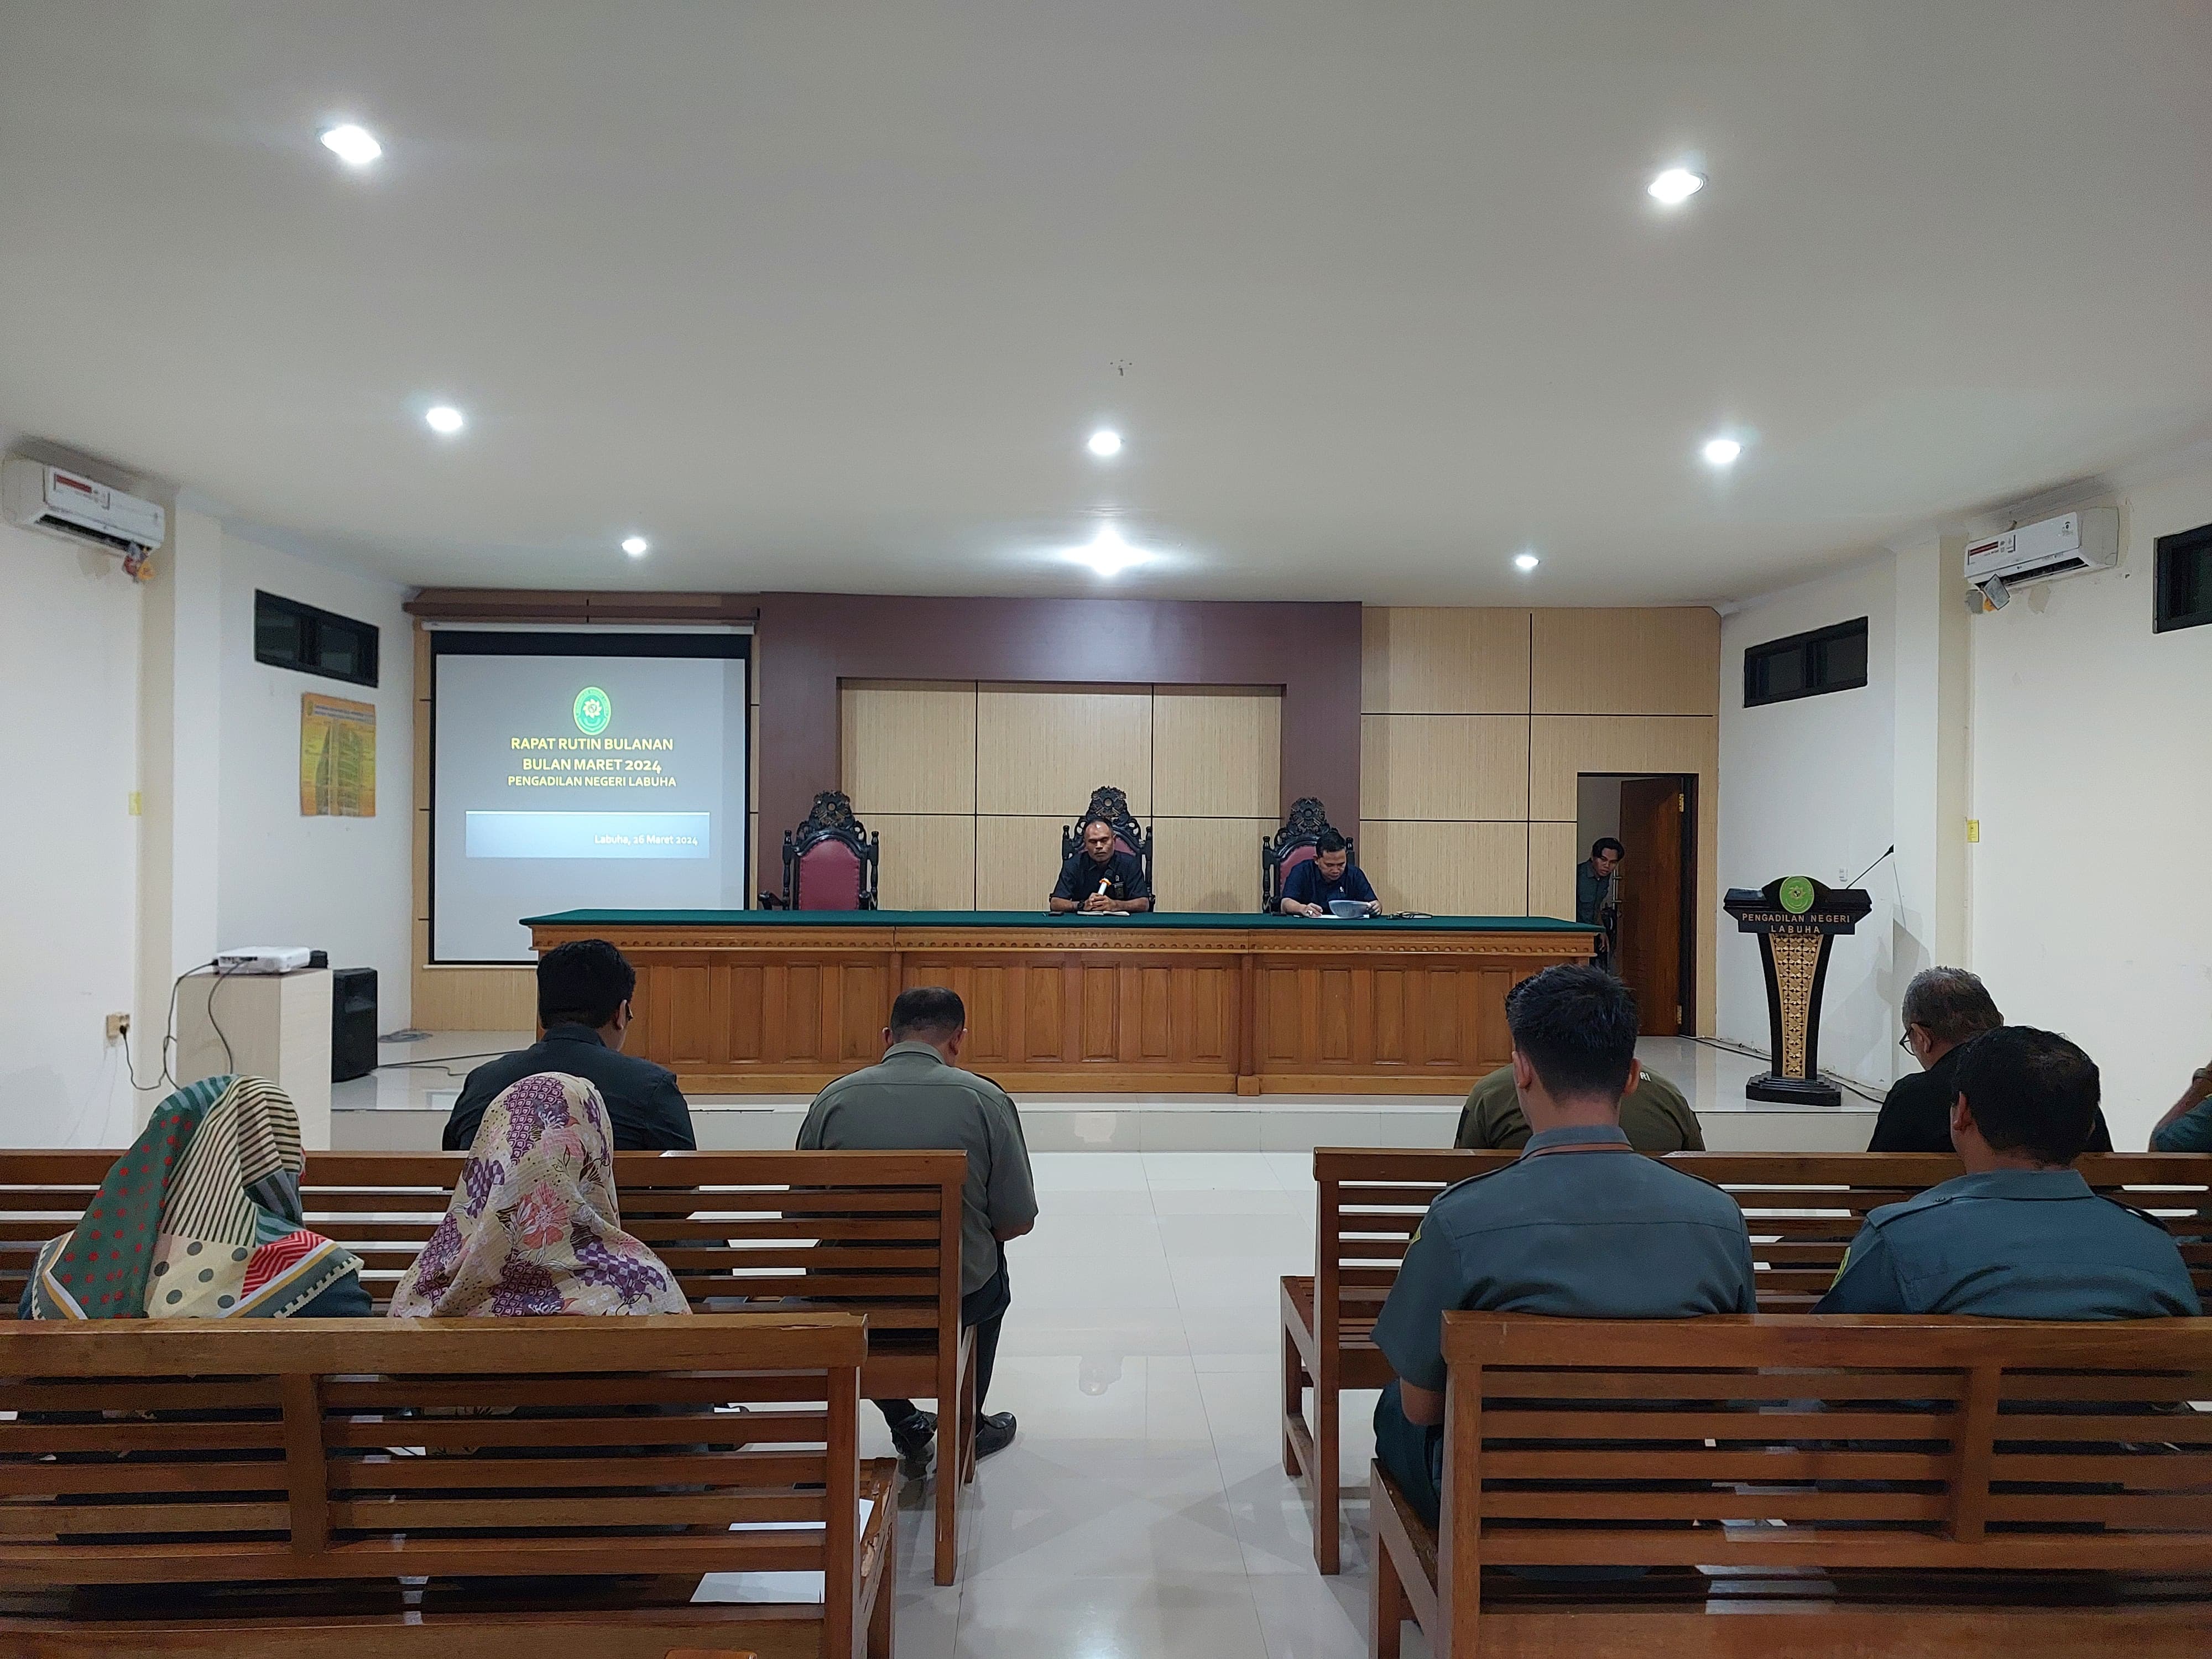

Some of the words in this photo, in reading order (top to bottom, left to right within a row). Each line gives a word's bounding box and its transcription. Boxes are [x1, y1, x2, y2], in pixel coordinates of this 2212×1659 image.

[511, 737, 556, 750] RAPAT
[558, 738, 601, 750] RUTIN
[604, 738, 674, 750] BULANAN
[523, 758, 571, 770] BULAN
[574, 759, 623, 771] MARET
[624, 760, 662, 774] 2024
[508, 776, 582, 786] PENGADILAN
[585, 776, 626, 787] NEGERI
[628, 776, 676, 787] LABUHA
[594, 834, 631, 846] Labuha,
[633, 834, 645, 844] 26
[646, 834, 674, 844] Maret
[676, 836, 698, 846] 2024
[1742, 913, 1804, 922] PENGADILAN
[1811, 914, 1850, 923] NEGERI
[1771, 925, 1820, 933] LABUHA
